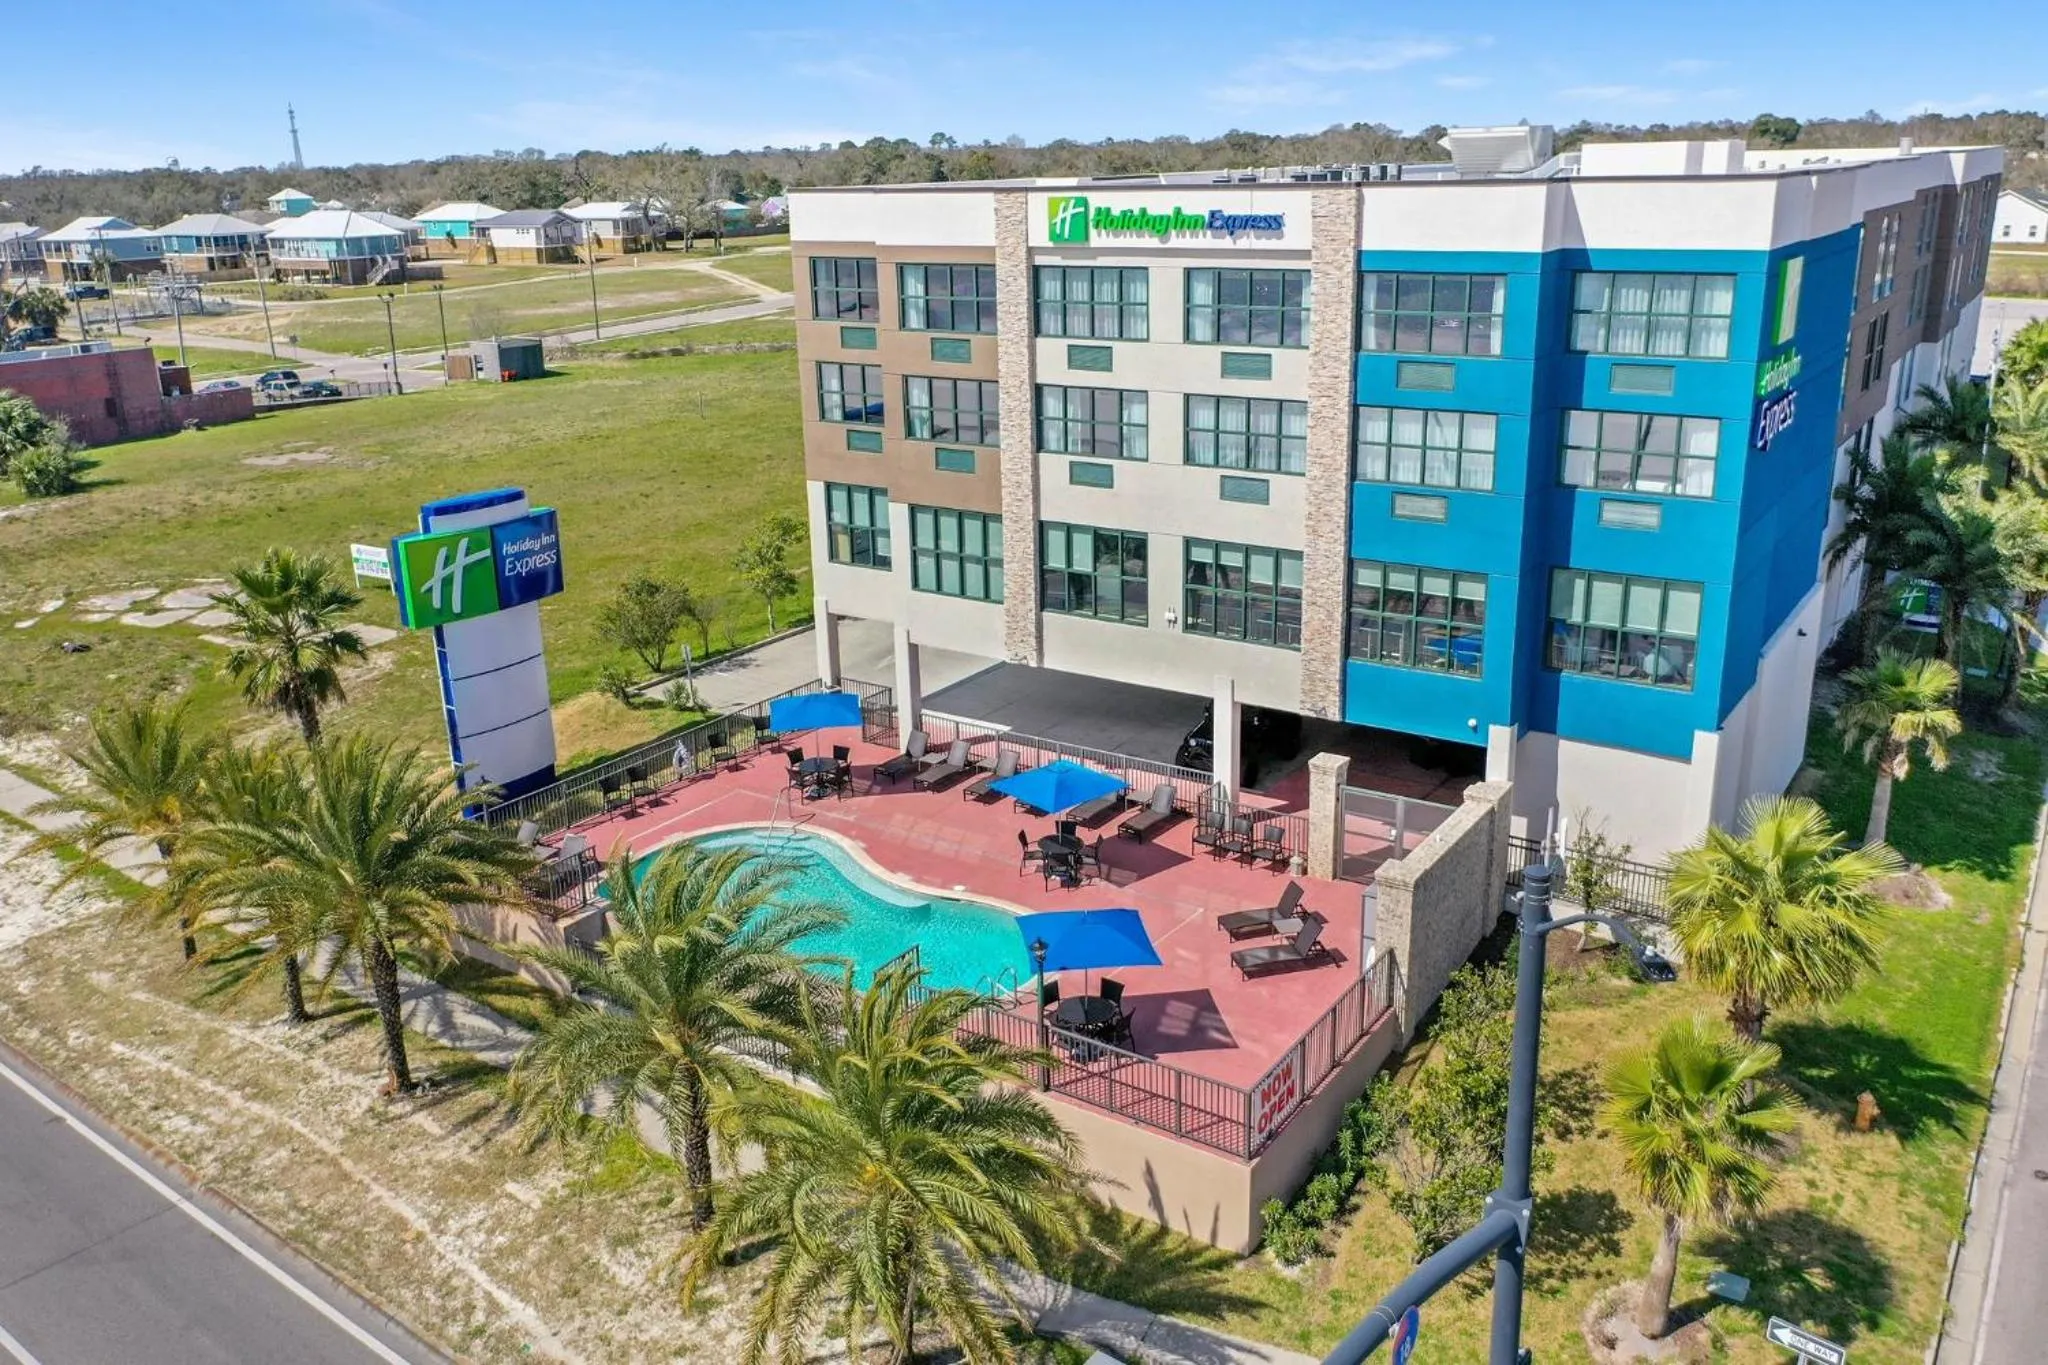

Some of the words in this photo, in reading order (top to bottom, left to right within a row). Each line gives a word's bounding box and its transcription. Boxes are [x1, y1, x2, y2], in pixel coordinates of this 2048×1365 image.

[1092, 206, 1170, 236] Holiday
[1171, 206, 1206, 231] Inn
[1206, 209, 1283, 235] Express
[1759, 354, 1790, 396] Holiday
[1790, 347, 1802, 377] Inn
[1757, 391, 1797, 452] Express
[503, 537, 541, 556] Holiday
[541, 533, 556, 546] Inn
[505, 550, 557, 576] Express
[1261, 1058, 1293, 1110] NOW
[1257, 1079, 1295, 1134] OPEN
[1791, 1334, 1809, 1350] ONE
[1814, 1344, 1835, 1359] WAY
